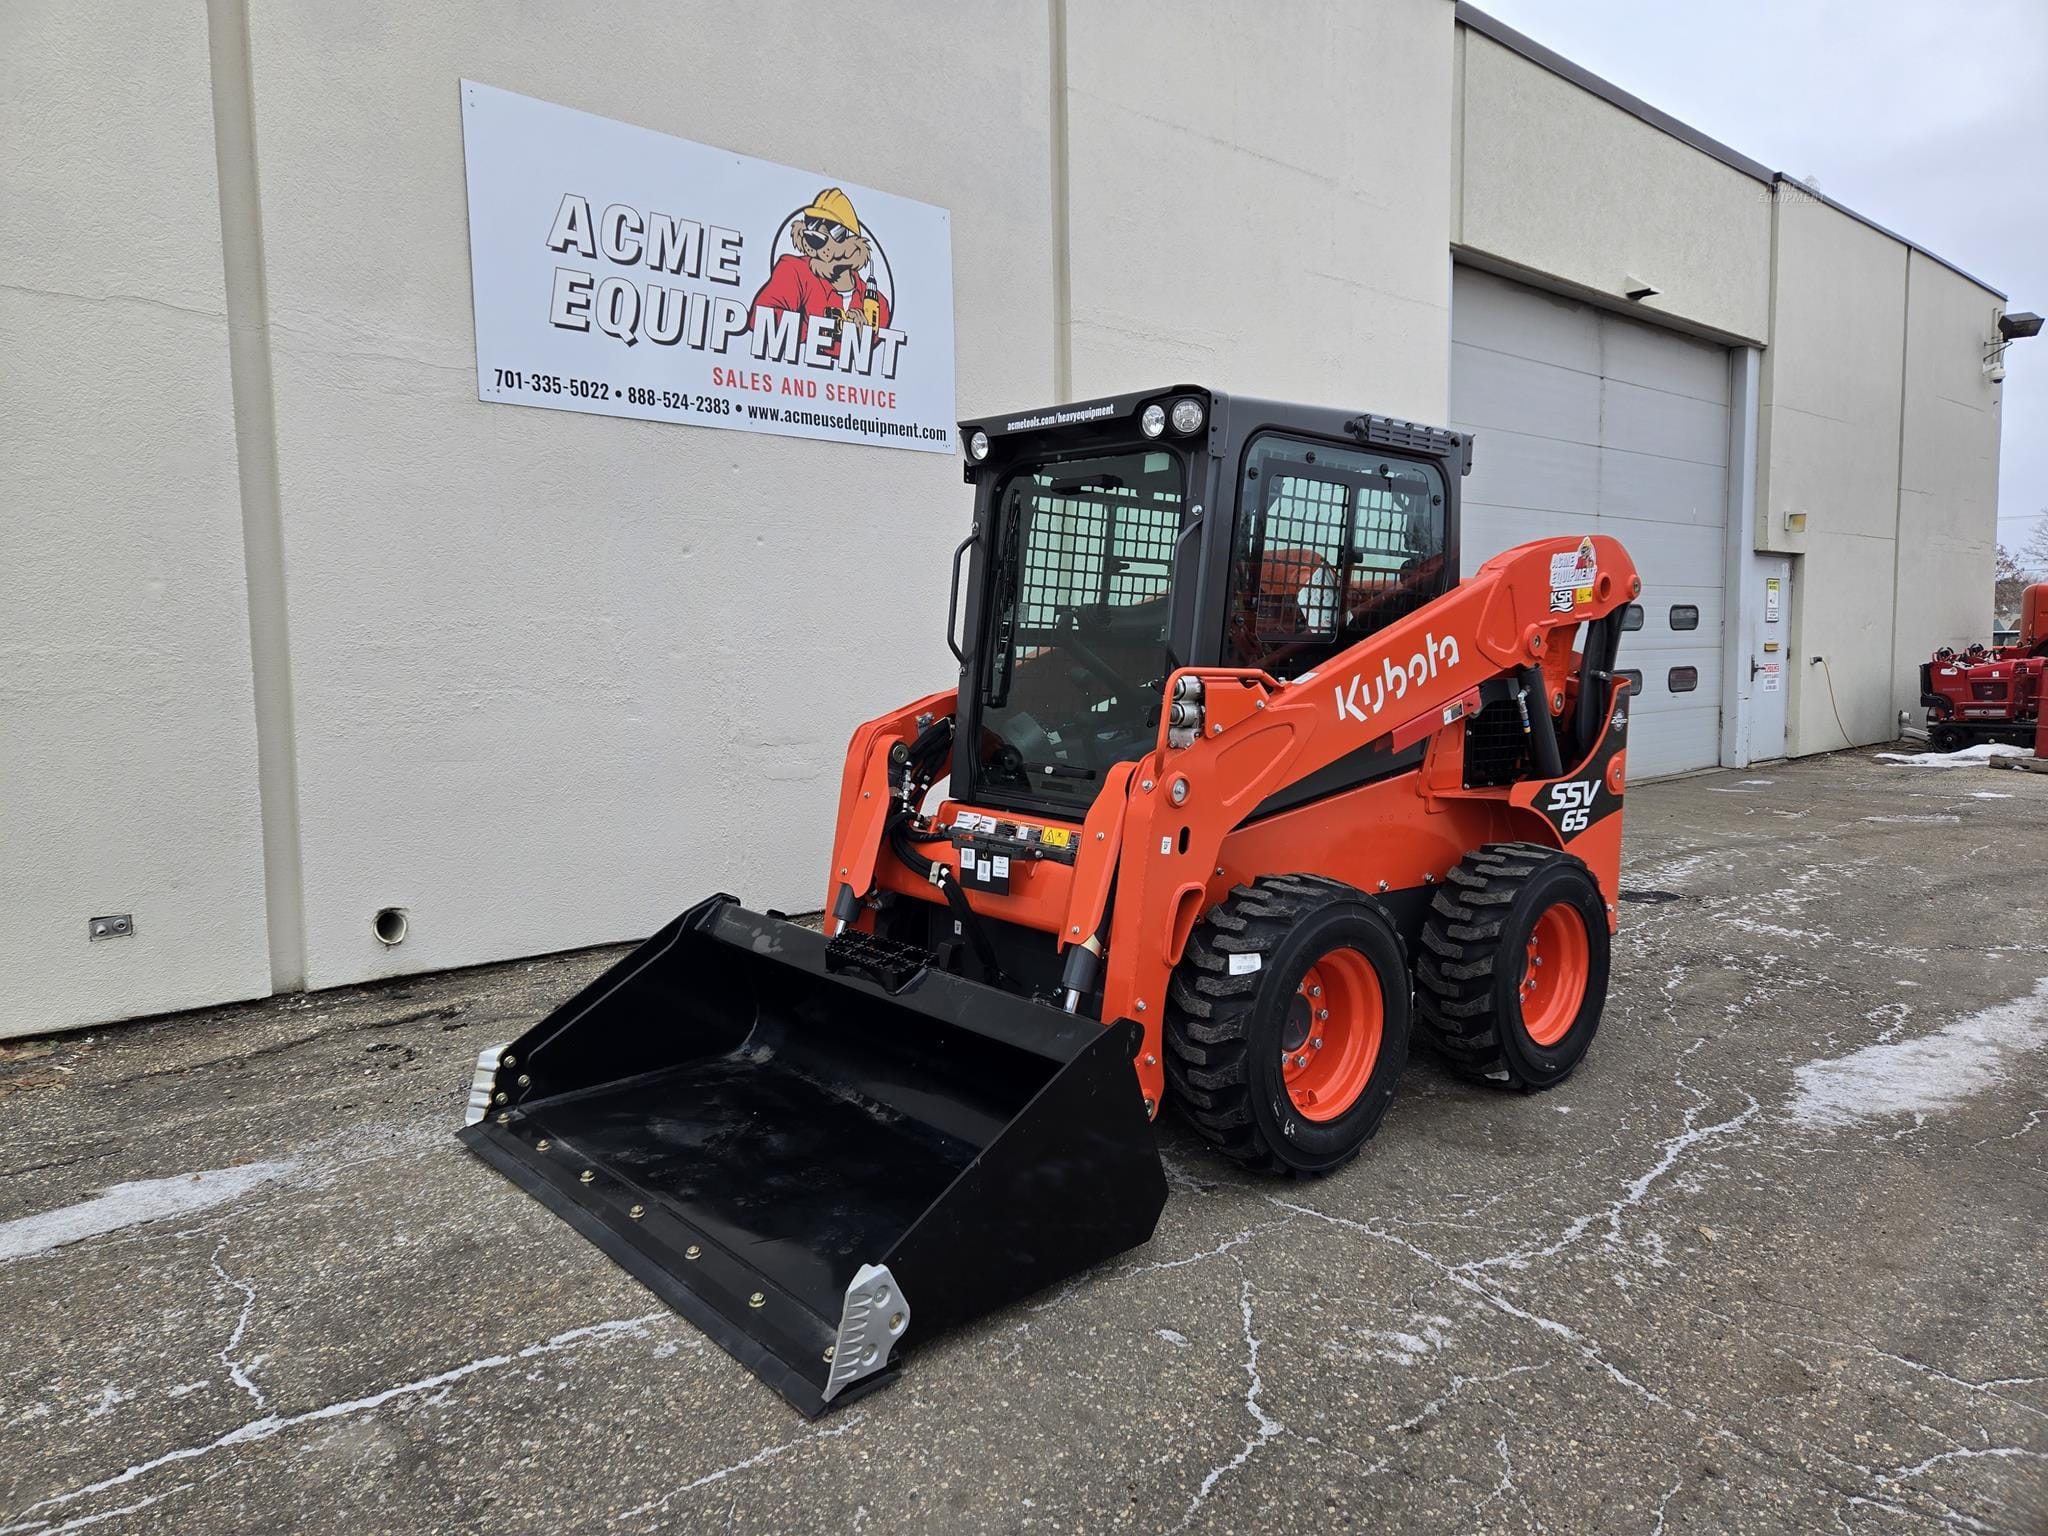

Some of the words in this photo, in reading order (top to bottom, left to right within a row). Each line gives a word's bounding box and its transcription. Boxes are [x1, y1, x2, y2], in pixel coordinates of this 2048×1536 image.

[546, 193, 743, 287] ACME
[549, 266, 907, 379] EQUIPMENT
[494, 368, 609, 400] 701-335-5022
[628, 386, 730, 416] 888-524-2383
[748, 404, 947, 441] www.acmeusedequipment.com
[713, 367, 772, 392] SALES
[781, 377, 817, 398] AND
[826, 383, 897, 409] SERVICE
[1007, 403, 1114, 431] acmetools.com/heavyequipment
[1550, 590, 1573, 604] KSR
[1335, 632, 1459, 722] Kubota
[1547, 780, 1602, 811] SSV
[1561, 808, 1590, 832] 65
